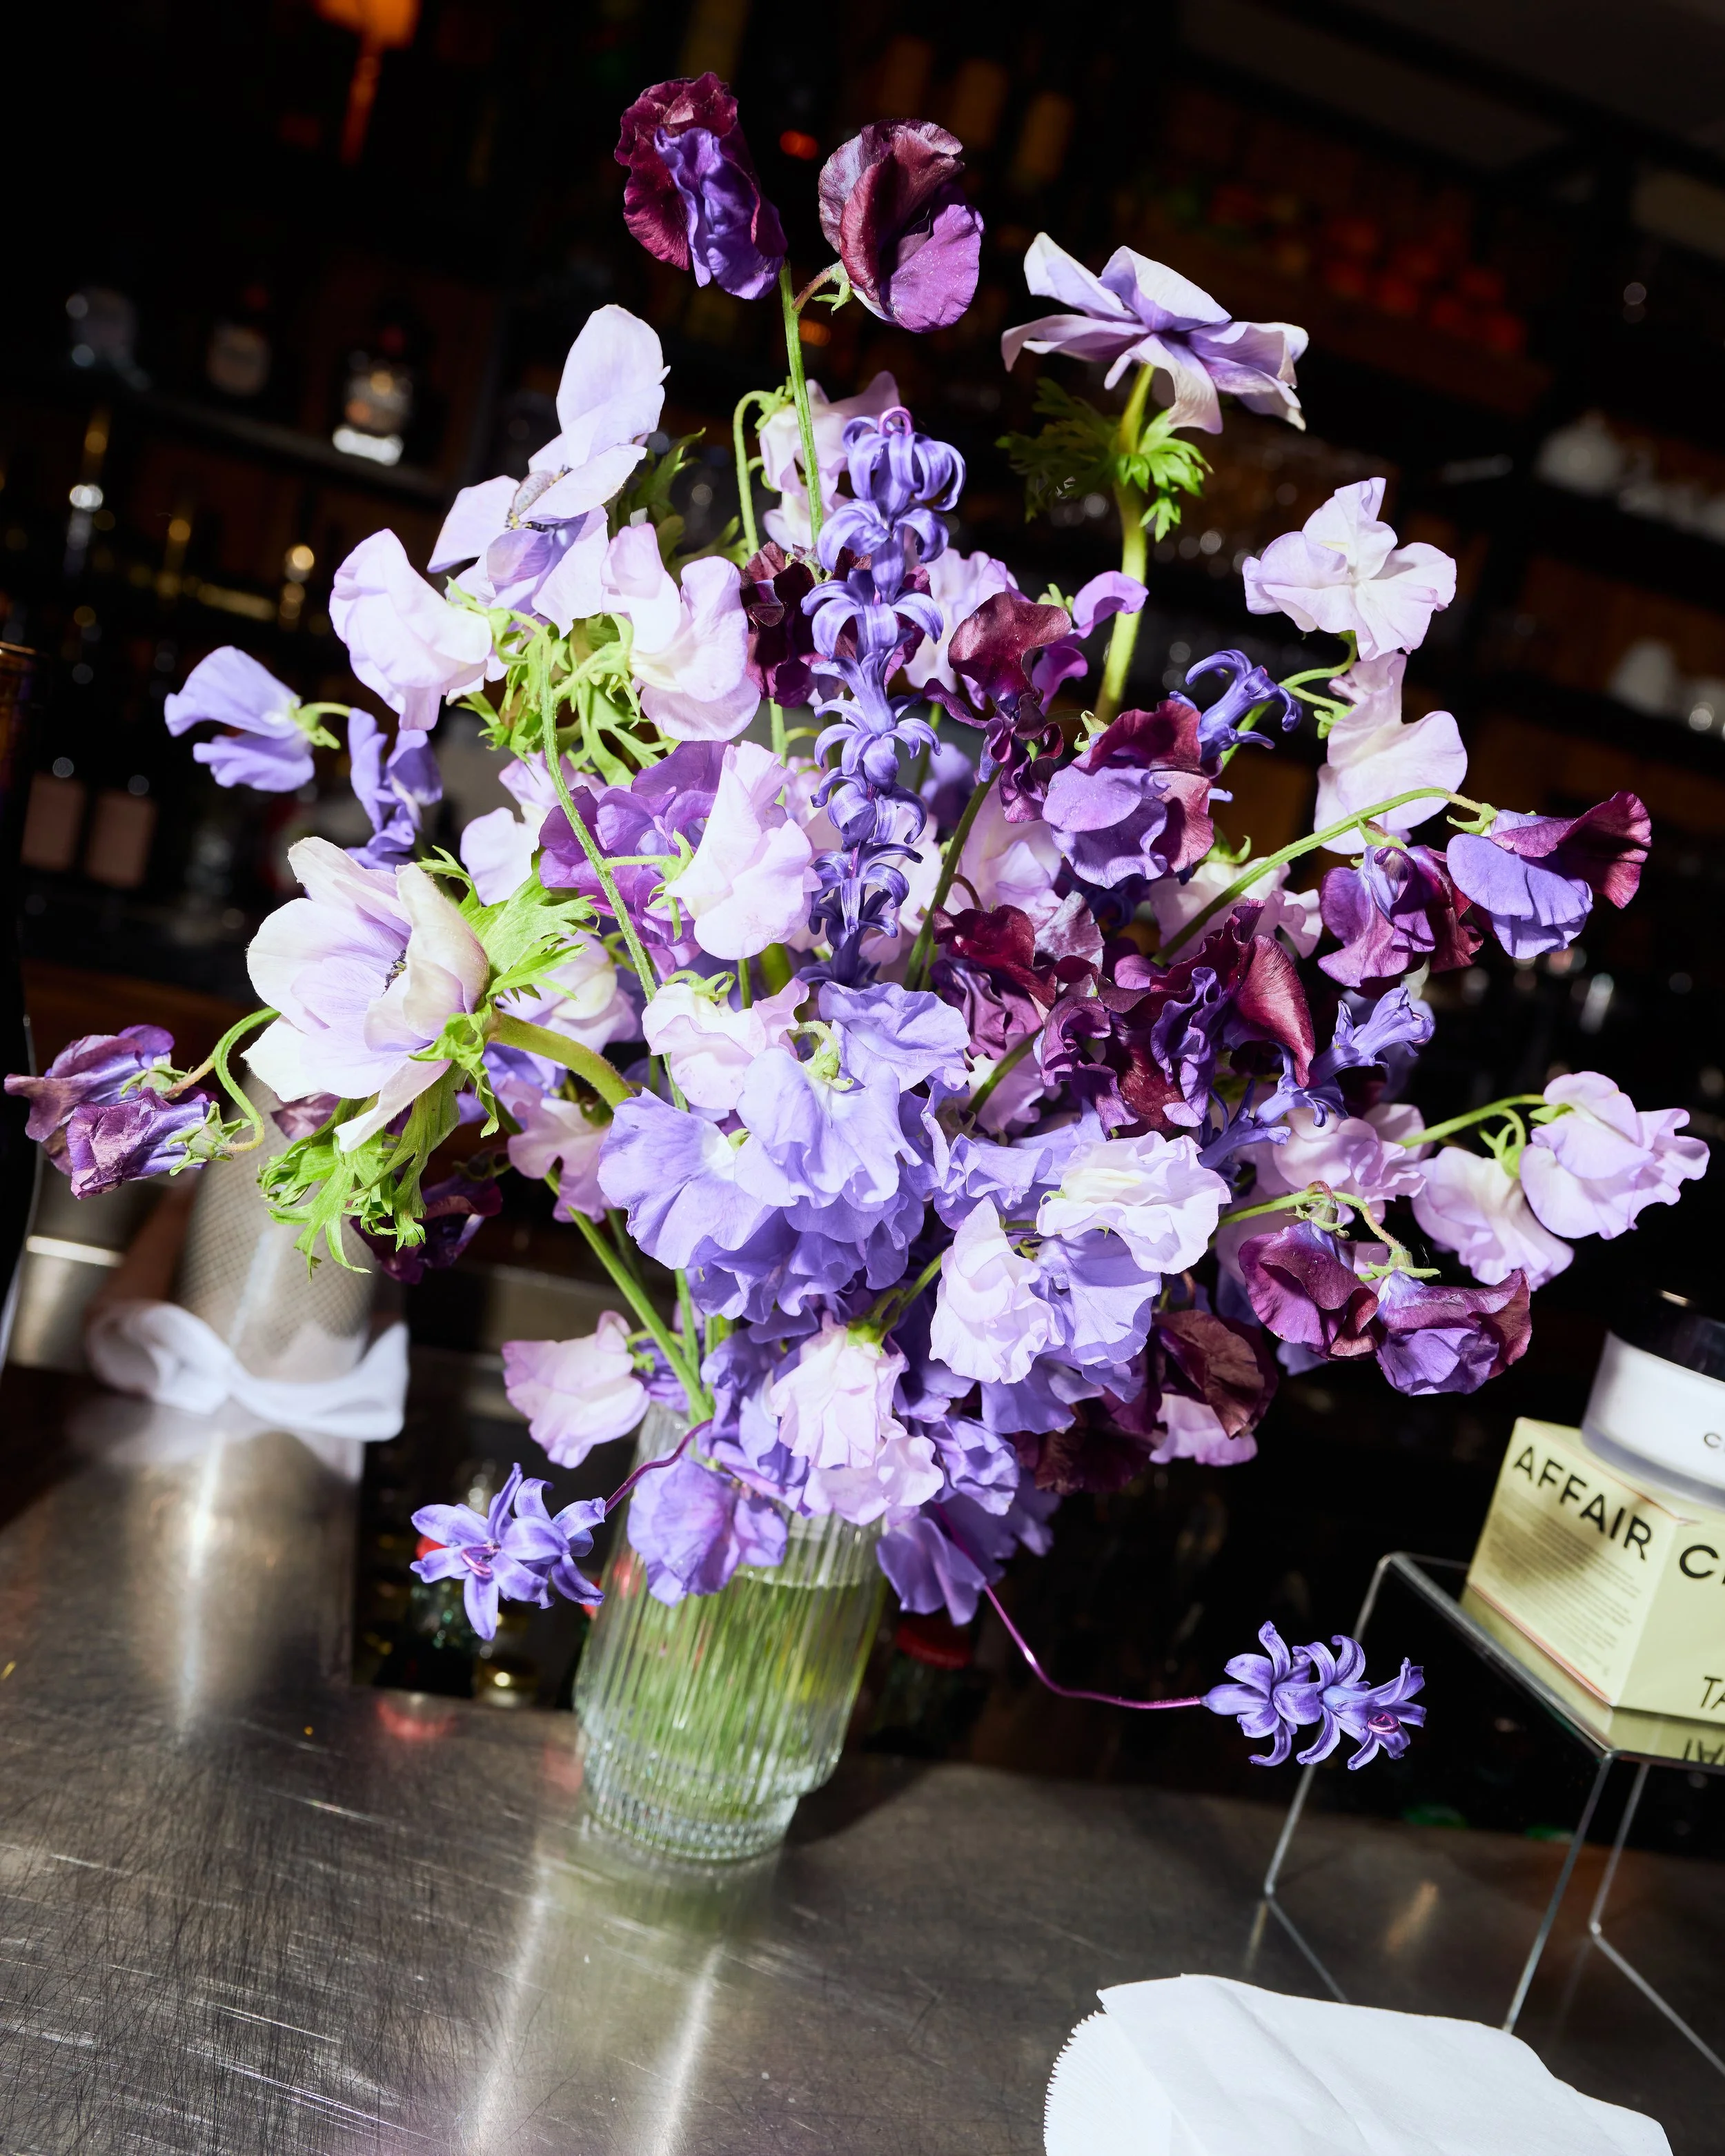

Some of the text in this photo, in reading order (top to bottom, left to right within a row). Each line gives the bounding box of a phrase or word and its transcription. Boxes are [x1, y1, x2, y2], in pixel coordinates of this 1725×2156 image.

[1704, 1432, 1725, 1453] C
[1513, 1445, 1652, 1561] AFFAIR
[1679, 1545, 1725, 1585] C
